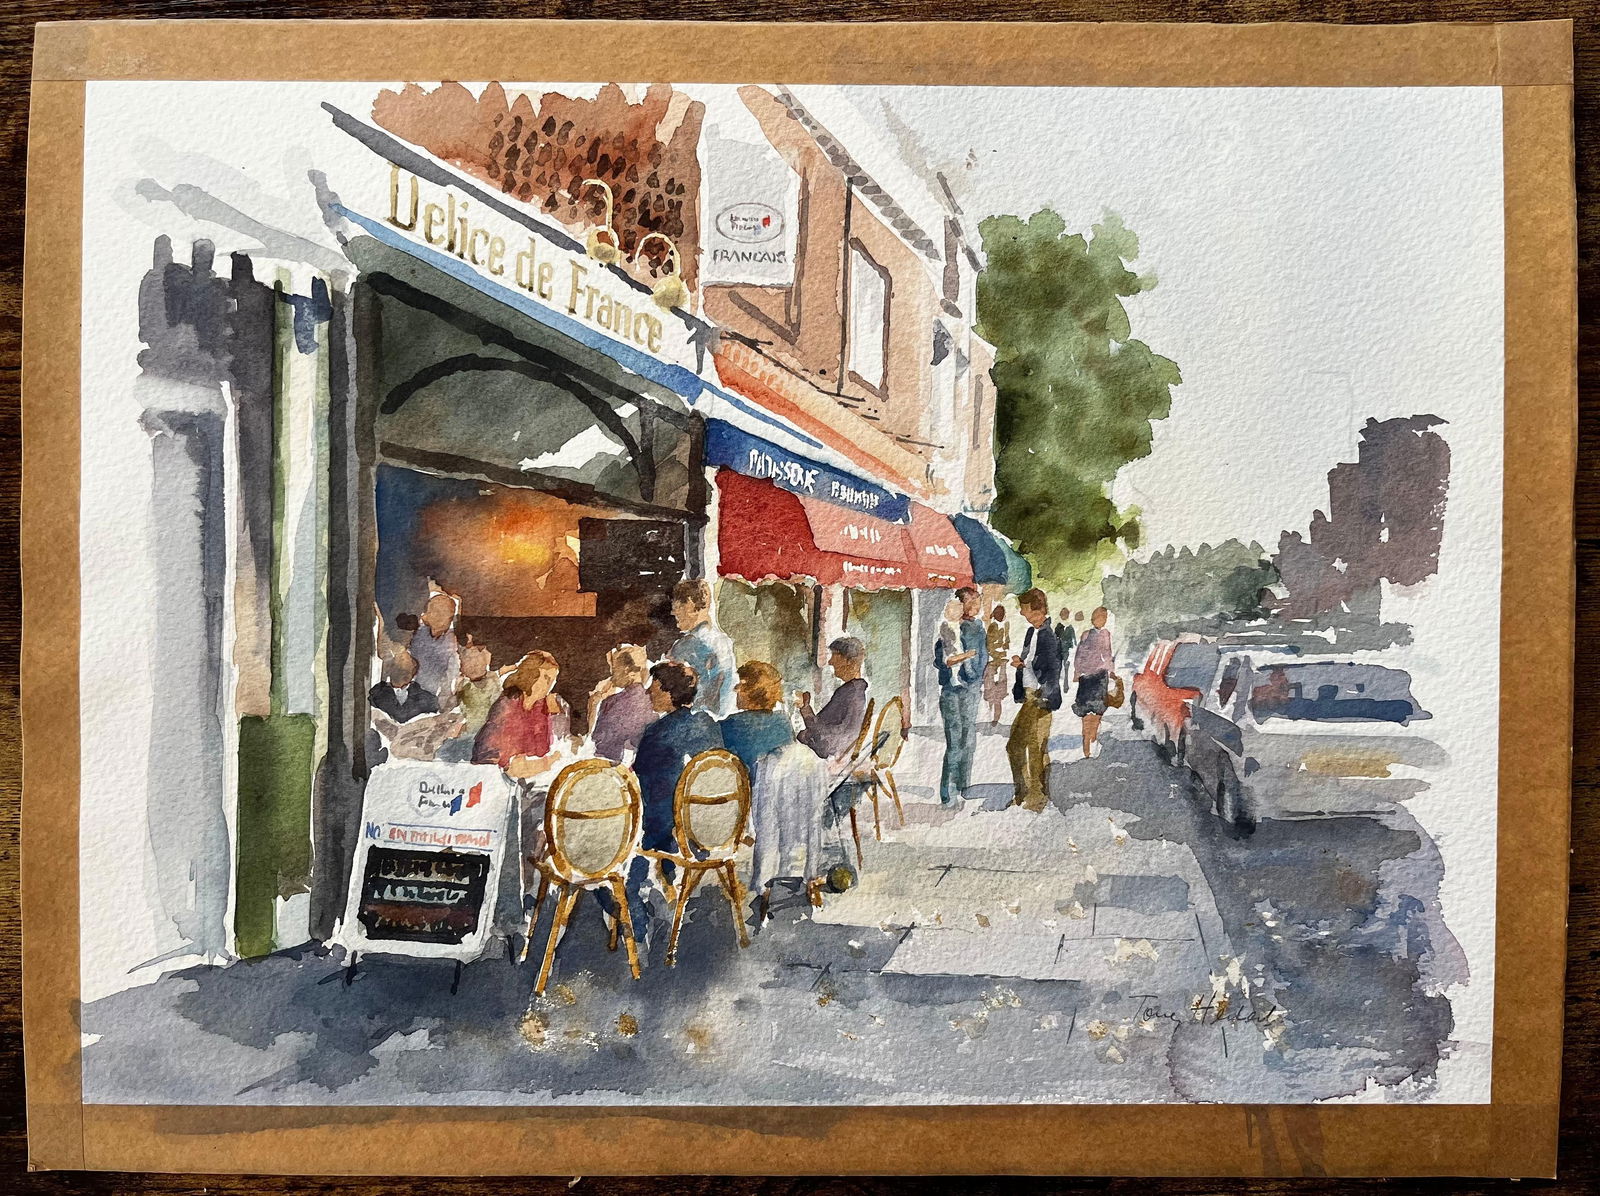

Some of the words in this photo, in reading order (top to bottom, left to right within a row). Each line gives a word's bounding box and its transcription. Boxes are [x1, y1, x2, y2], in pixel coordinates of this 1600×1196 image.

[383, 161, 506, 276] Delice
[515, 235, 553, 302] de
[567, 258, 663, 354] France
